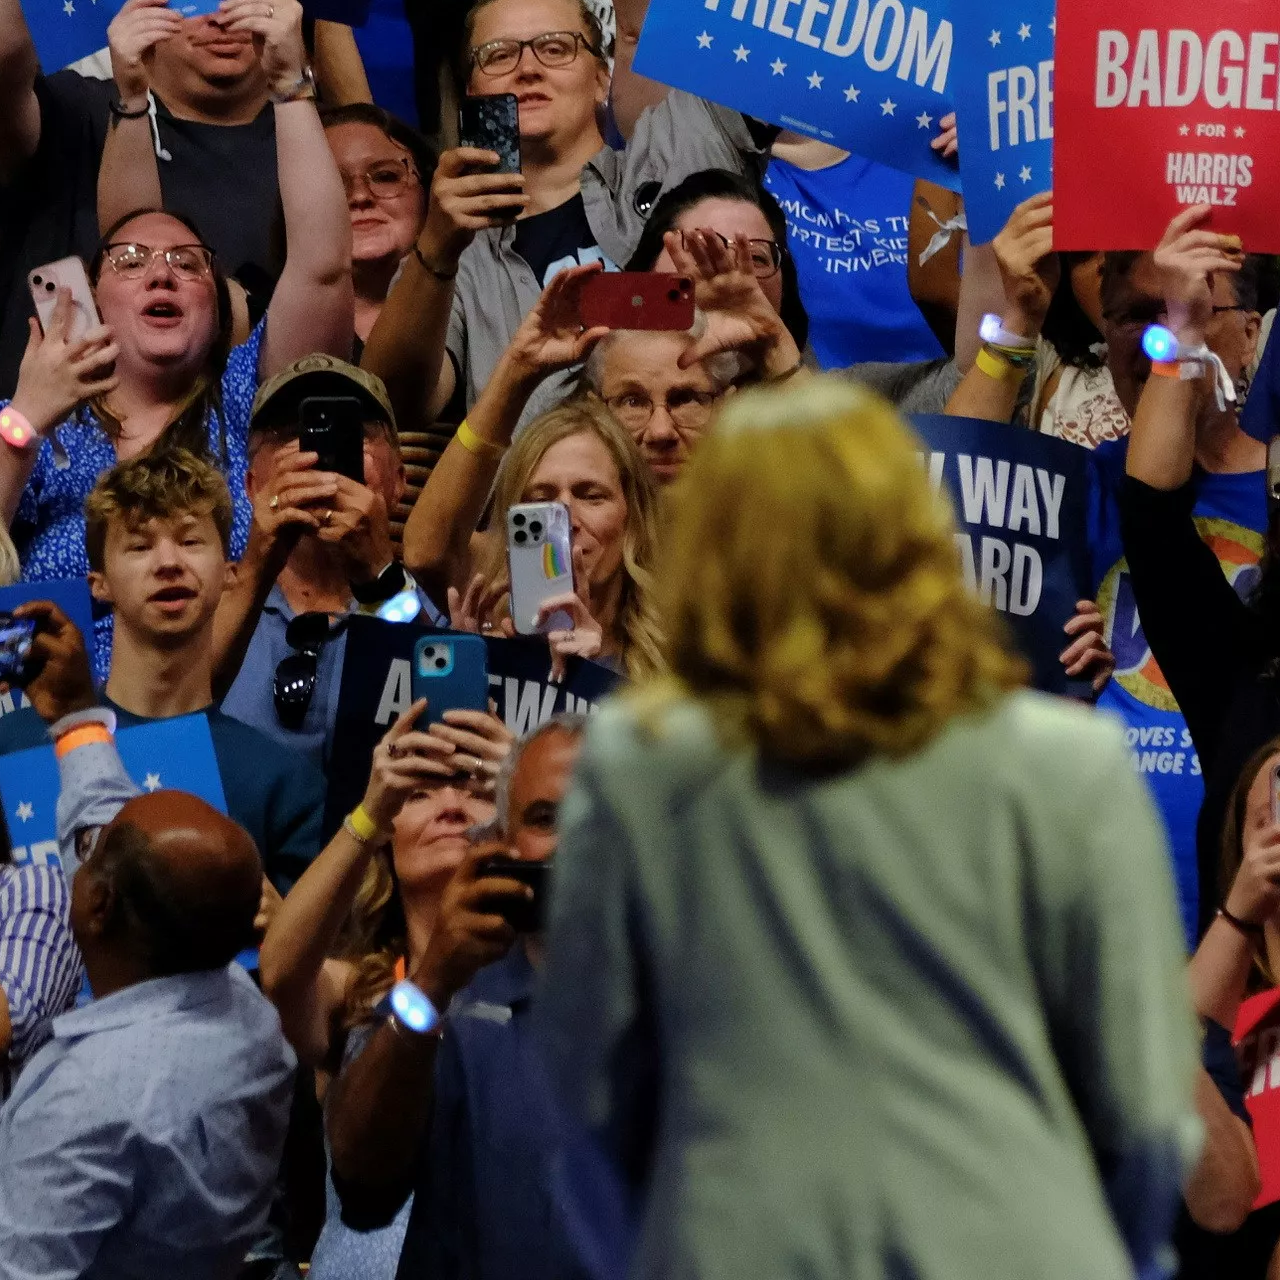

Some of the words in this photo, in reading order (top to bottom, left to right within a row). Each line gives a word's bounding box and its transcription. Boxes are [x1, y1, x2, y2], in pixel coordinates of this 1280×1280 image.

[1196, 124, 1226, 137] FOR
[1166, 153, 1253, 188] HARRIS
[1176, 185, 1236, 206] WALZ
[957, 453, 1066, 539] WAY
[374, 658, 412, 725] A
